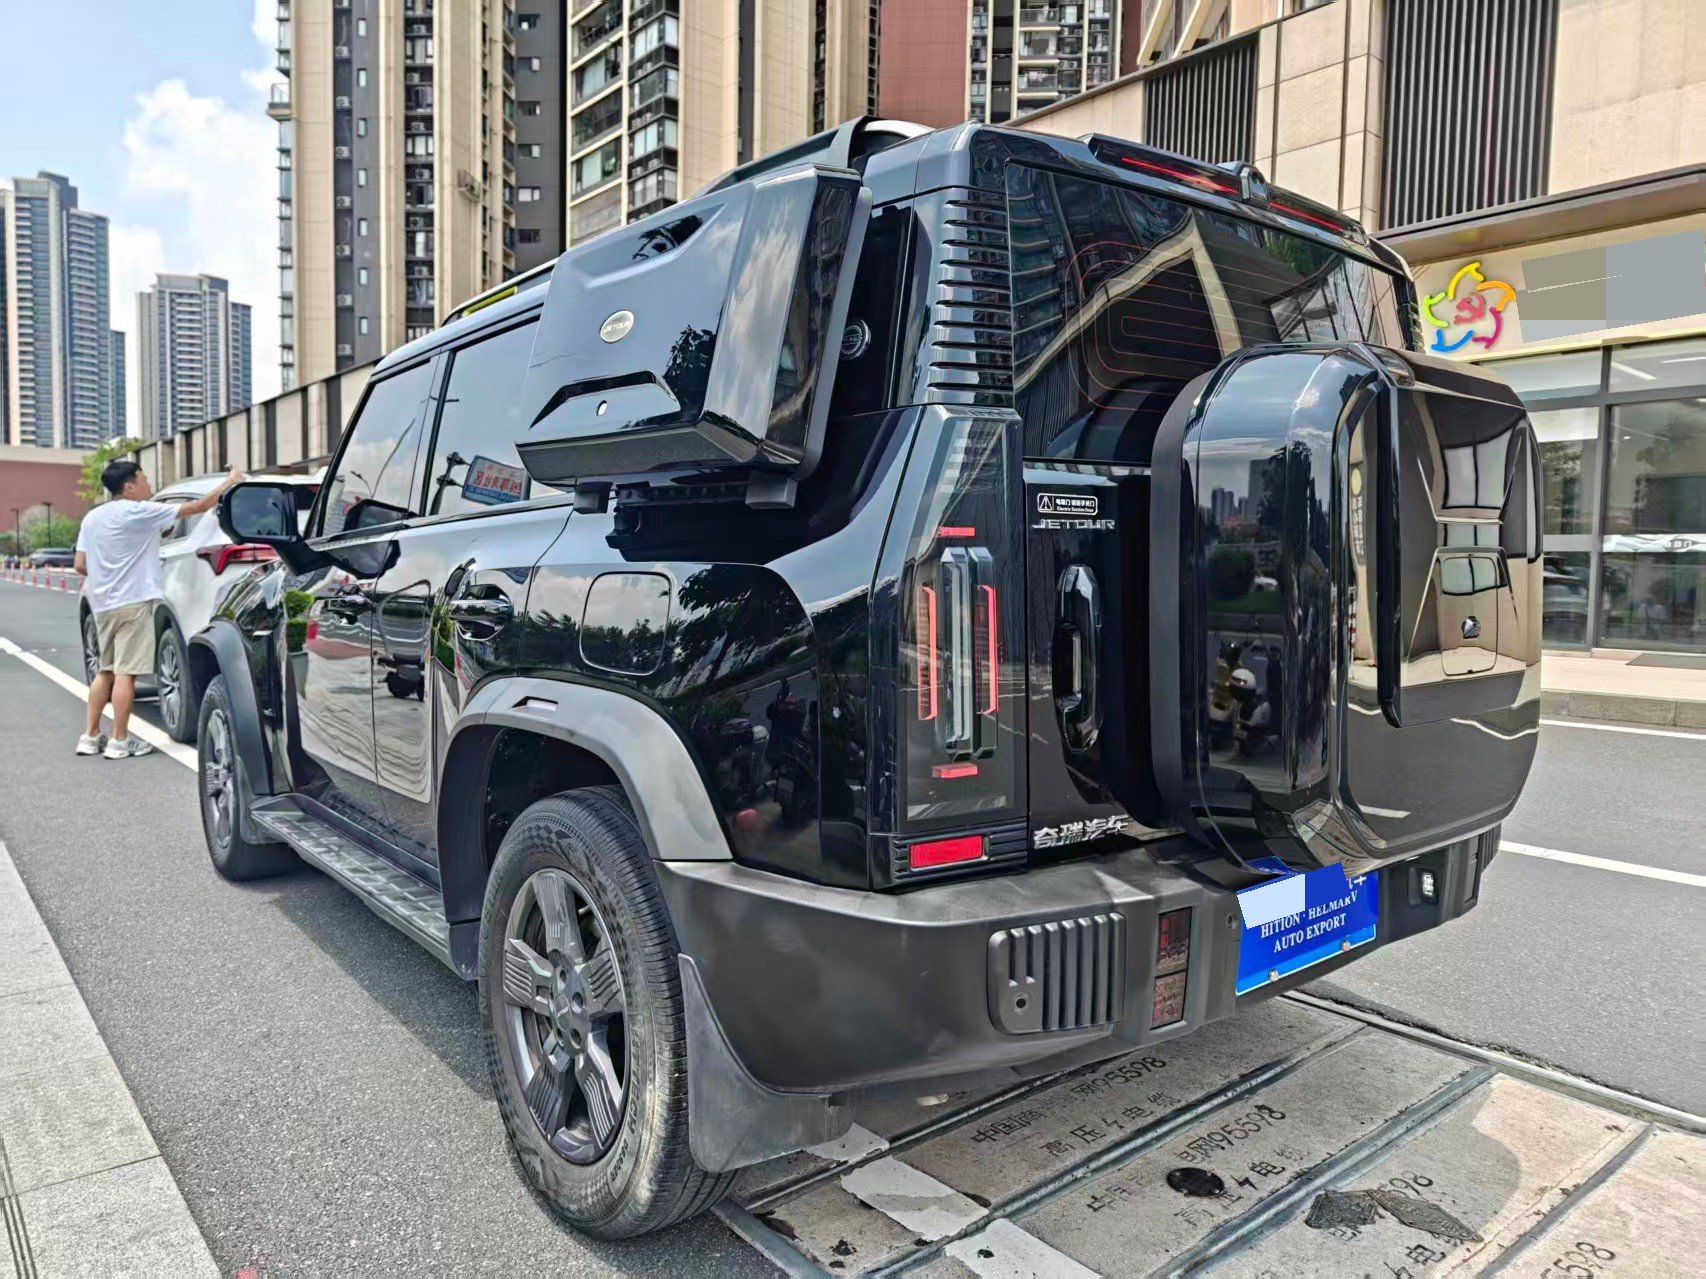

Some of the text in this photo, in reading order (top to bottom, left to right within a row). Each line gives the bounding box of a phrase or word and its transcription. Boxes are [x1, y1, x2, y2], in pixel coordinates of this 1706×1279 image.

[1030, 519, 1116, 530] JETOUR
[1034, 814, 1129, 849] 奇瑞汽车
[1261, 912, 1300, 939] HITION
[1273, 912, 1347, 953] AUTO EXPORT
